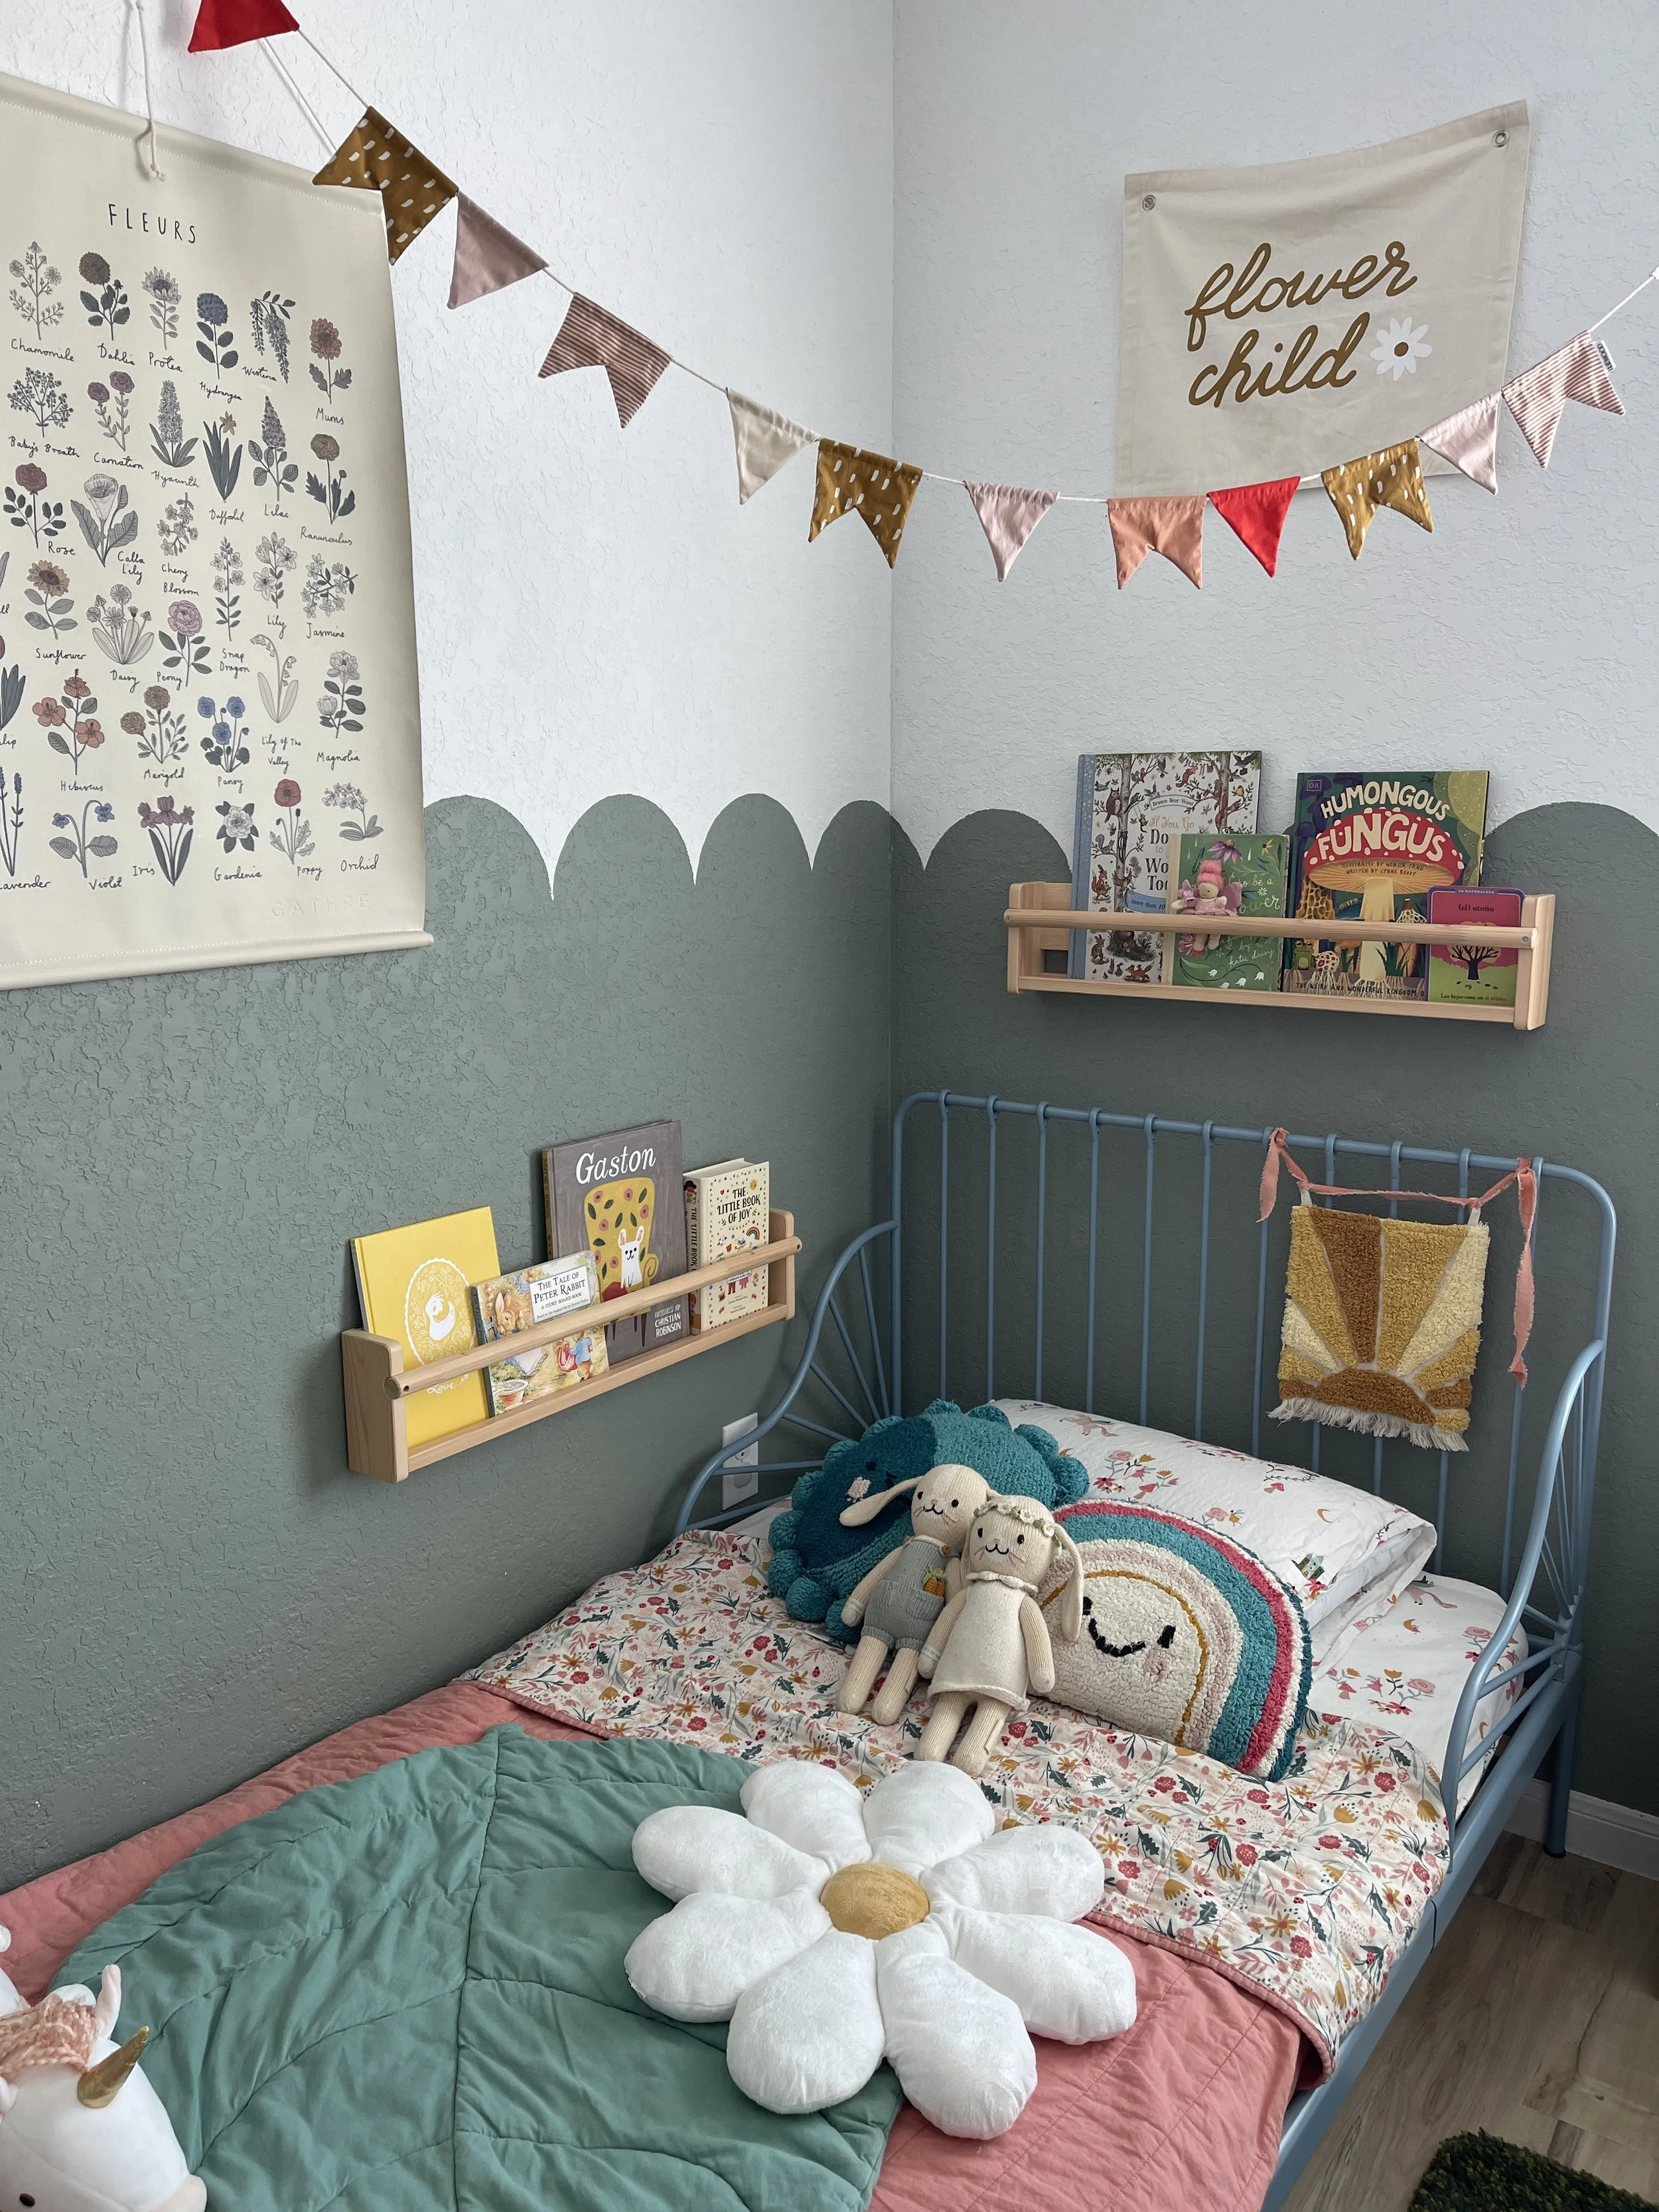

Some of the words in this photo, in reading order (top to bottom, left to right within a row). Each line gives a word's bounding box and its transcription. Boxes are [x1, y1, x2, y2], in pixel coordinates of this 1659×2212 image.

[108, 203, 196, 244] FLEURS
[1185, 241, 1417, 351] flower
[11, 338, 74, 362] Chamomile
[97, 343, 135, 366] Dahlia
[149, 351, 182, 372] Protea
[1188, 312, 1370, 408] child
[199, 382, 242, 404] Hydrangea
[315, 407, 344, 425] Mums
[9, 435, 38, 458] Baby's
[44, 443, 80, 458] Breath
[94, 452, 143, 470] Carnation
[208, 508, 244, 525] Daffodil
[264, 503, 289, 518] Lilac
[300, 526, 353, 546] Ranunculus
[48, 541, 76, 555] Rose
[117, 551, 145, 564] Calla
[122, 564, 143, 585] Lily
[161, 563, 188, 583] Cherry
[163, 582, 200, 596] Blossom
[267, 615, 287, 639] Lily
[306, 623, 345, 638] Jasmine
[36, 648, 86, 665] Sunflower
[222, 648, 245, 664] Snap
[220, 661, 250, 680] Dragon
[109, 669, 141, 694] Daisy
[156, 671, 182, 691] Peony
[261, 734, 277, 753] Lily
[267, 757, 289, 774] Valley
[316, 749, 360, 771] Magnolia
[60, 780, 104, 792] Hibiscus
[143, 767, 185, 788] Marigold
[217, 776, 244, 794] Pansy
[1181, 798, 1194, 806] Wood
[1321, 781, 1450, 821] HUMONGOUS
[1161, 816, 1179, 829] You
[1183, 816, 1194, 832] Go
[1149, 829, 1169, 844] Do
[1317, 813, 1446, 862] FUNGUS
[132, 863, 155, 877] Iris
[340, 853, 380, 872] Orchid
[1145, 858, 1169, 873] Wo
[214, 865, 263, 881] Gardenia
[297, 865, 323, 881] Poppy
[1252, 874, 1263, 886] be
[88, 876, 122, 890] Violet
[271, 893, 370, 917] GATHRE
[1238, 940, 1252, 953] by
[1228, 954, 1248, 968] katie
[1252, 949, 1275, 960] daisy
[1347, 986, 1384, 994] WONDERFUL
[1387, 988, 1417, 996] KINGDOM
[576, 1146, 656, 1184] Gaston
[732, 1187, 746, 1199] THE
[717, 1199, 740, 1215] LITTLE
[743, 1194, 761, 1208] BOOK
[728, 1212, 737, 1224] OF
[739, 1207, 752, 1222] JOY
[534, 1289, 558, 1303] PETER
[560, 1279, 585, 1295] RABBIT
[538, 1281, 551, 1291] THE
[553, 1274, 571, 1286] TALE
[558, 1295, 571, 1304] BOARD
[654, 1311, 681, 1327] CHRISTIAN
[656, 1321, 682, 1338] ROBINSON
